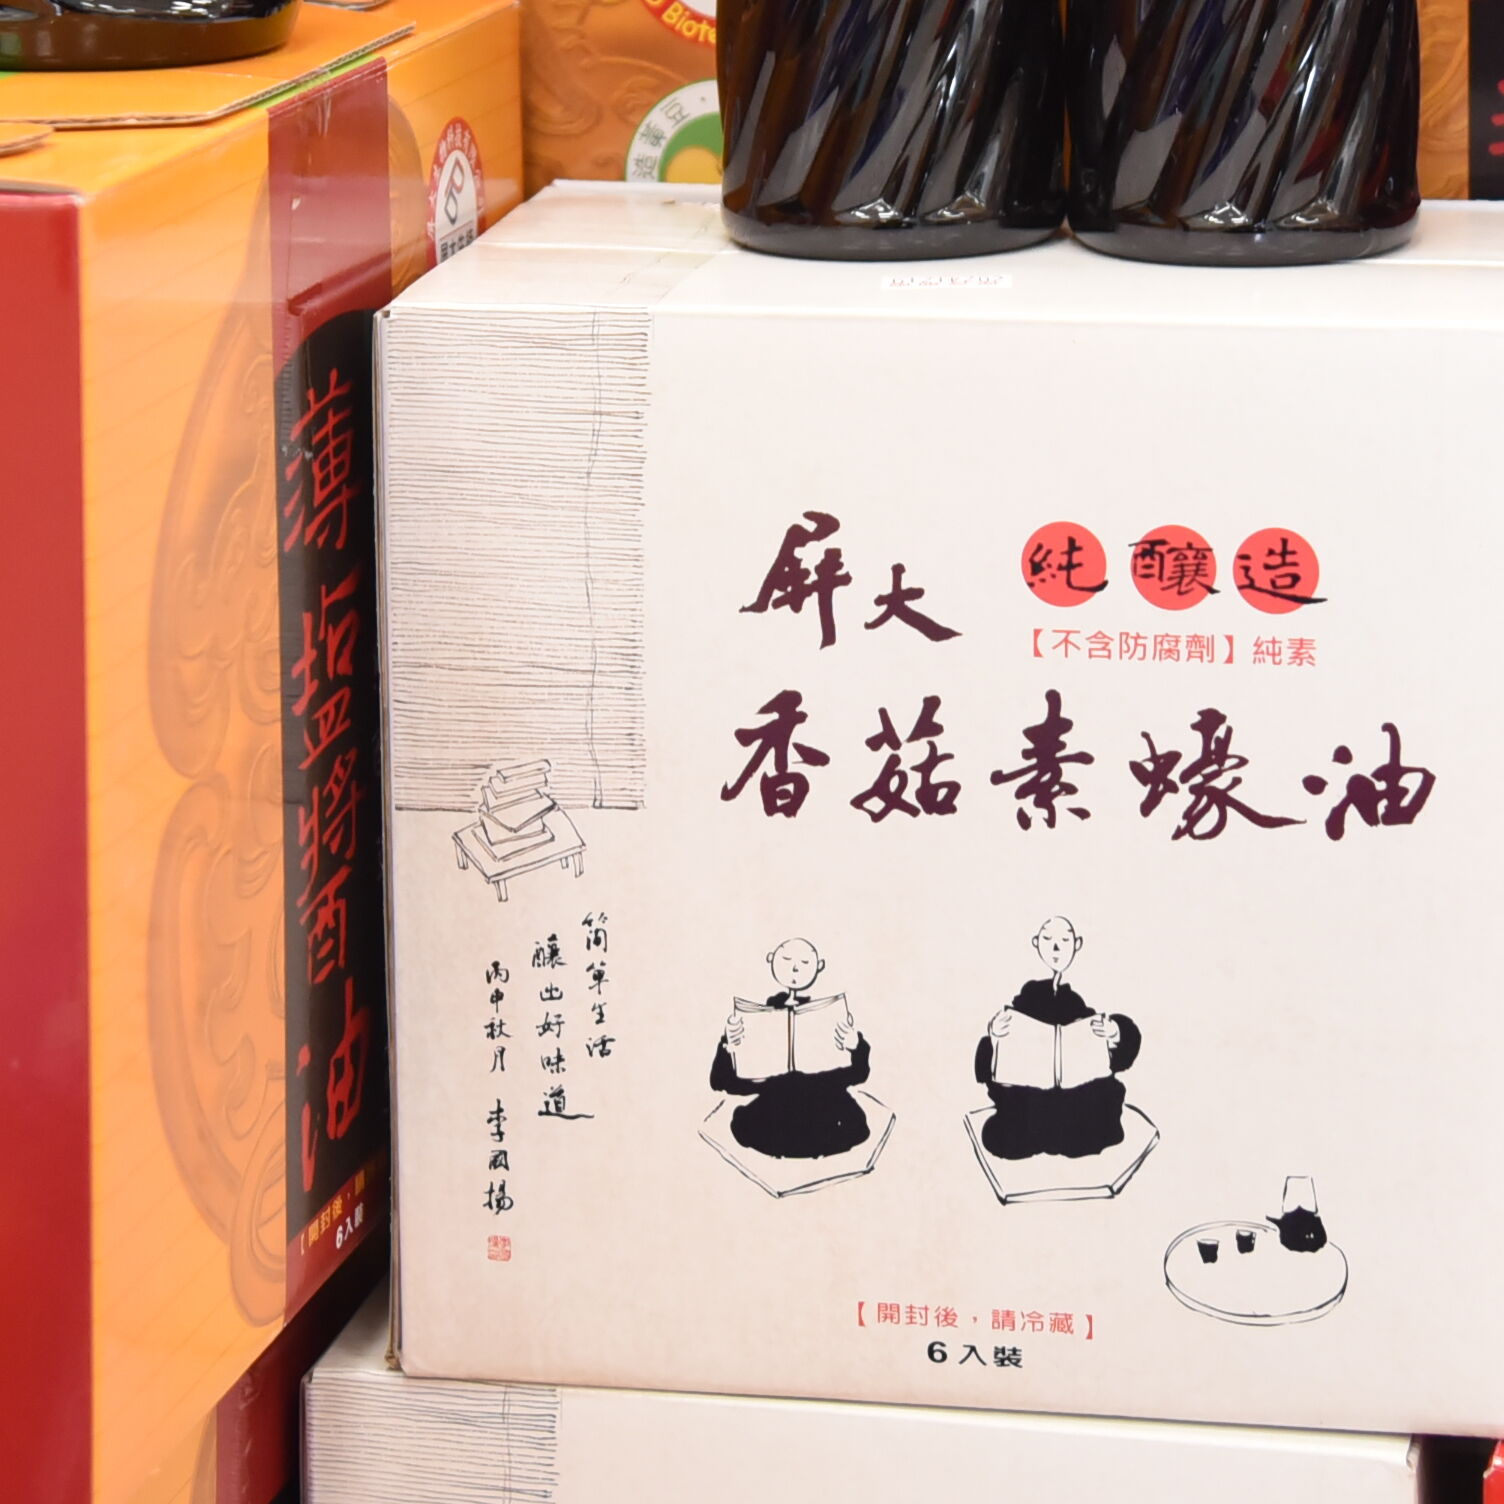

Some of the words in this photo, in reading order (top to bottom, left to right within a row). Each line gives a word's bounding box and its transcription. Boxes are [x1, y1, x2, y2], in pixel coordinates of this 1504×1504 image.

[740, 510, 963, 649] 屏大
[1027, 536, 1328, 604] 純釀造
[1252, 636, 1317, 667] 純素
[720, 689, 1436, 841] 香菇素蠔油
[927, 1341, 1023, 1369] 6入裝
